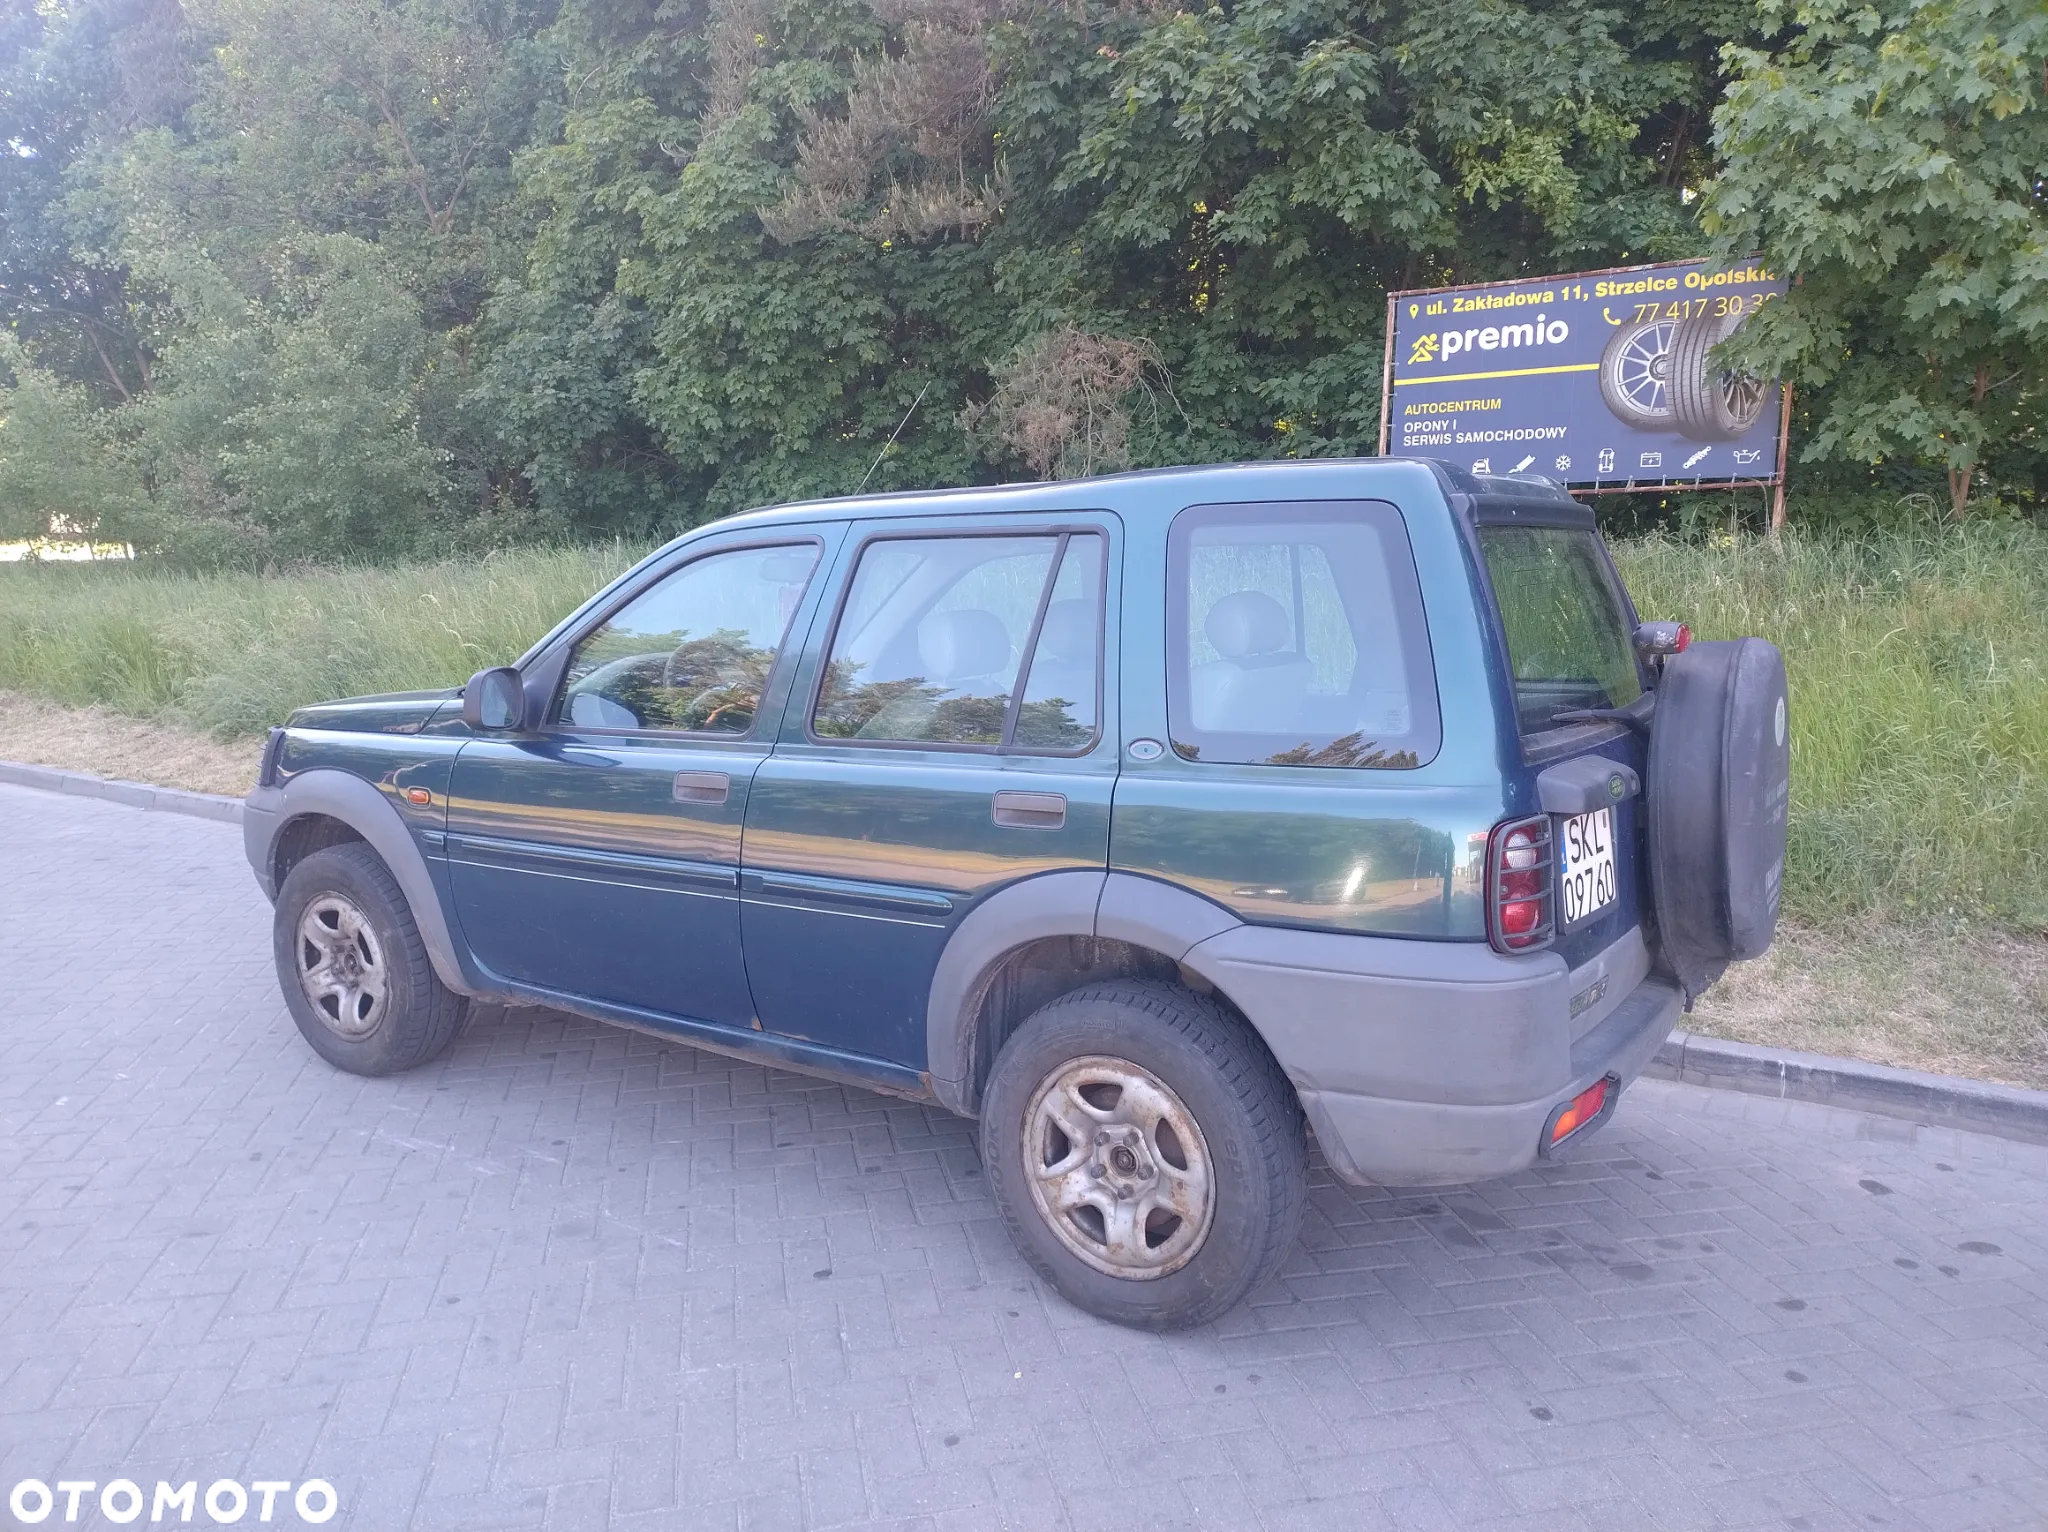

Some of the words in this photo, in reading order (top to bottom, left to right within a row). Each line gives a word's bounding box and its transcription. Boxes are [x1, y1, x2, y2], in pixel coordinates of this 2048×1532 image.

[1426, 300, 1448, 316] ul.
[1452, 290, 1554, 313] Zakładowa
[1561, 284, 1589, 302] 11,
[1595, 276, 1678, 298] Strzelce
[1634, 303, 1664, 324] 77
[1665, 298, 1708, 319] 417
[1714, 295, 1743, 316] 30
[1441, 313, 1569, 362] premio
[1404, 398, 1502, 416] AUTOCENTRUM
[1403, 419, 1450, 433] OPONY
[1452, 418, 1458, 431] I
[1403, 433, 1452, 447] SERWIS
[1455, 426, 1567, 444] SAMOCHODOWY
[1568, 811, 1604, 864] SKL
[1564, 859, 1616, 922] 09760
